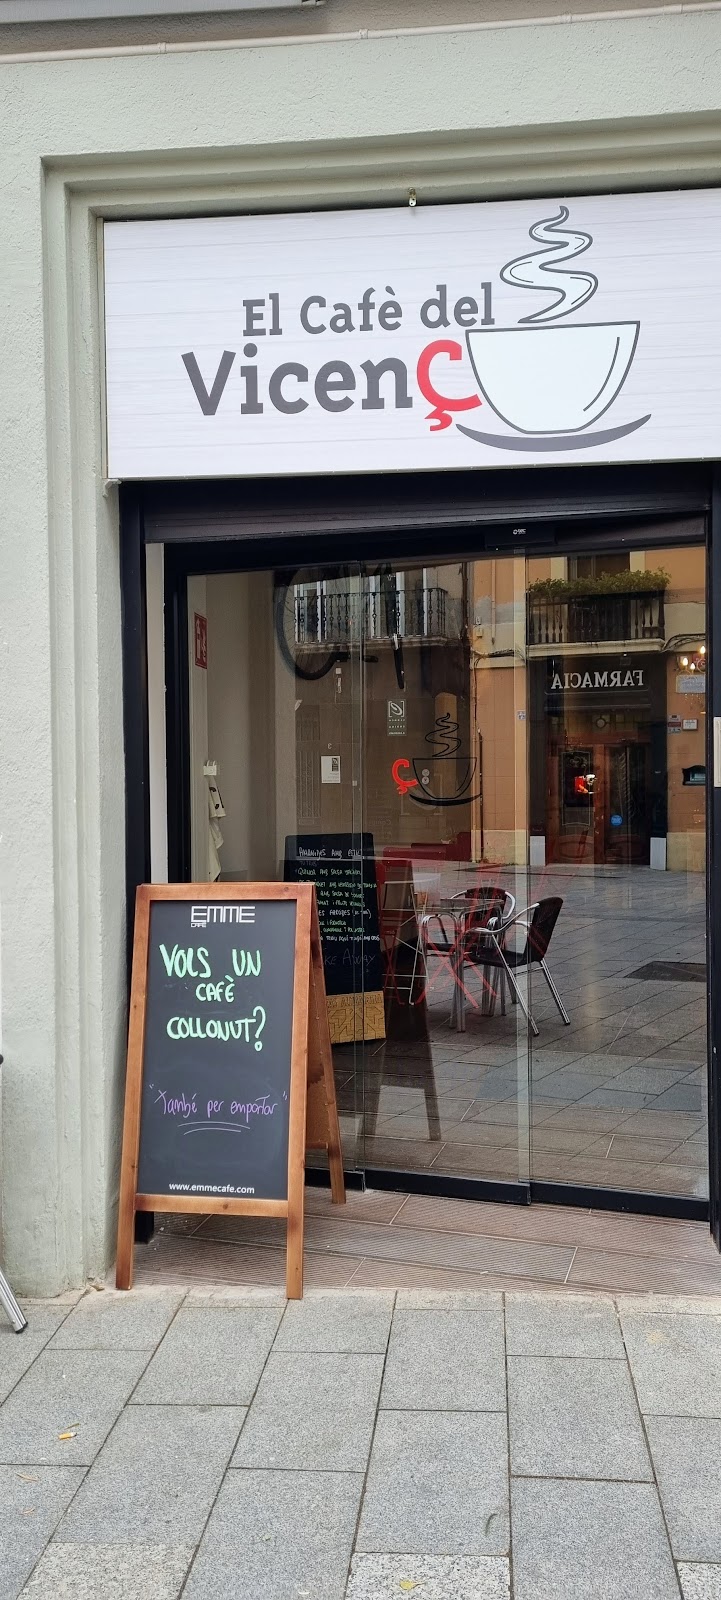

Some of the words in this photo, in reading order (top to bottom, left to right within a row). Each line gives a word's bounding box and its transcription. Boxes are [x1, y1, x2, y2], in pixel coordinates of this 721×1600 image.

[243, 293, 283, 337] El
[300, 285, 403, 335] Cafè
[420, 282, 496, 330] del
[190, 905, 256, 923] EMME
[159, 943, 212, 978] VOLS
[231, 948, 262, 977] UN
[195, 974, 235, 1003] CAFÈ
[166, 1005, 266, 1052] COLLONUT?
[206, 1099, 225, 1119] per
[168, 1182, 255, 1195] www.emmecafe.com
